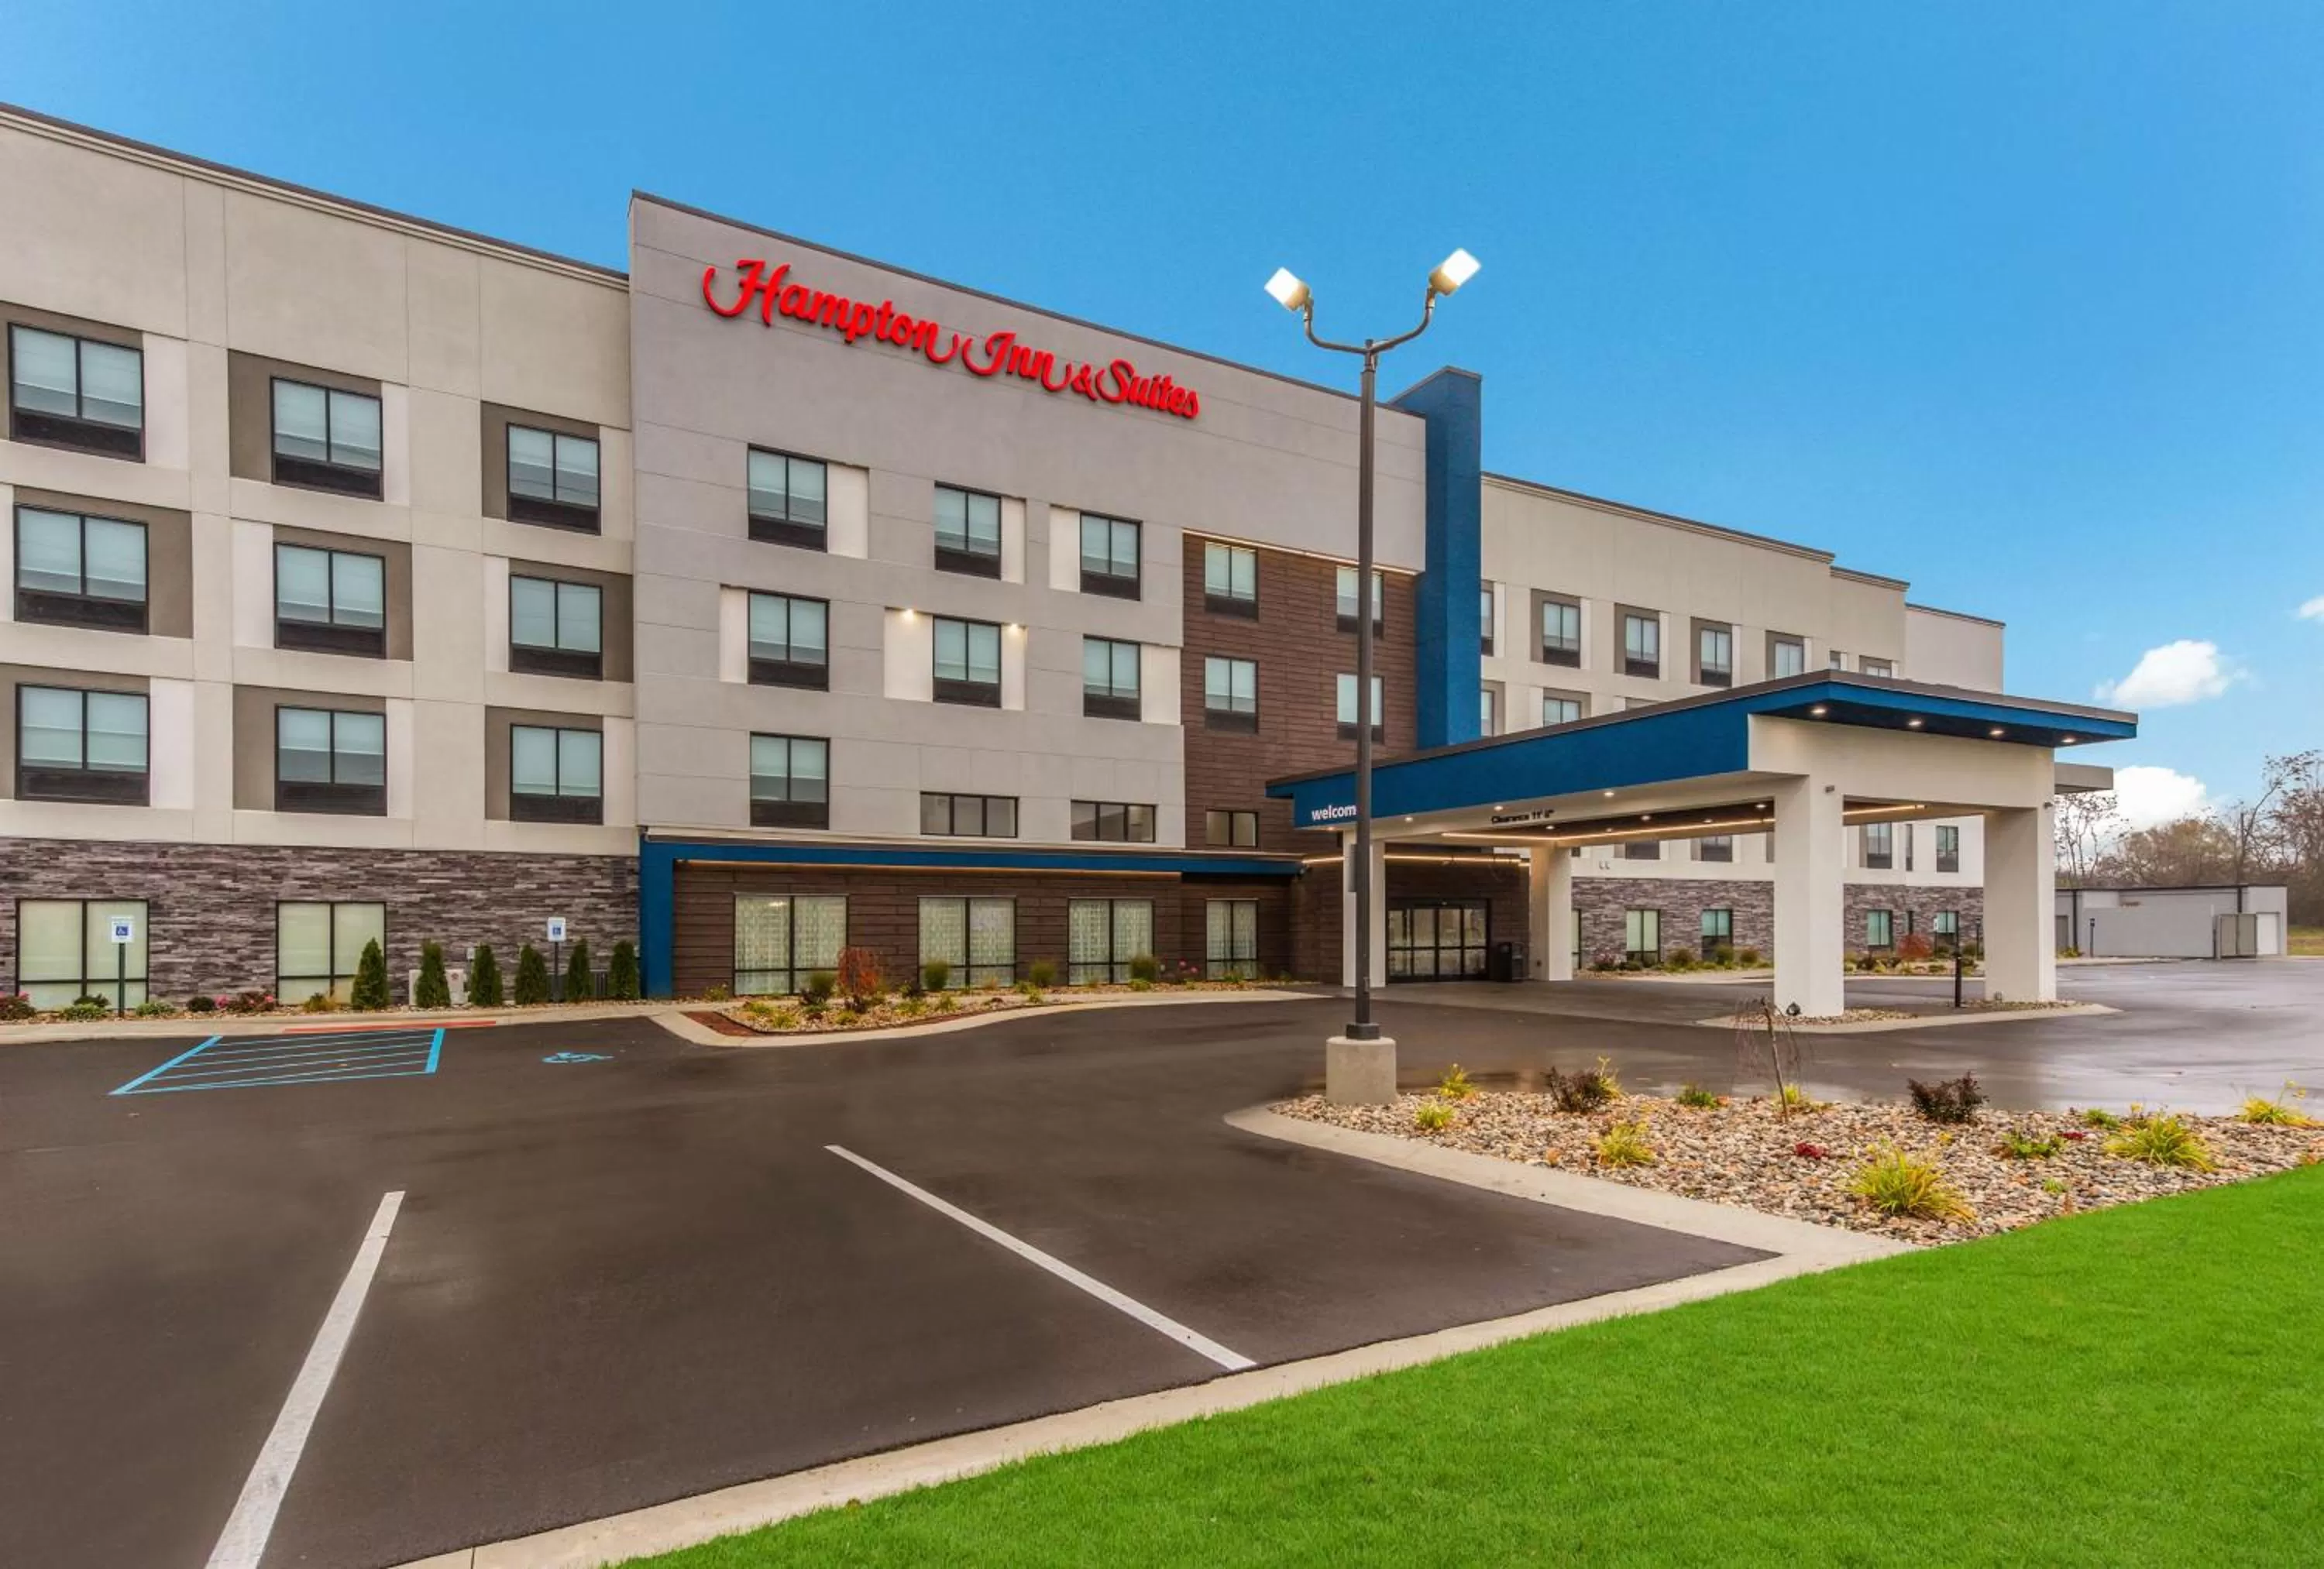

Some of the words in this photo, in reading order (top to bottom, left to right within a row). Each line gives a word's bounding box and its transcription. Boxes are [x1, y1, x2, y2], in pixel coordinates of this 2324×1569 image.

[703, 260, 961, 362] Hampton
[962, 331, 1072, 393] Inn
[1071, 361, 1098, 400] &
[1095, 359, 1199, 419] Suites
[1312, 805, 1357, 821] welcom
